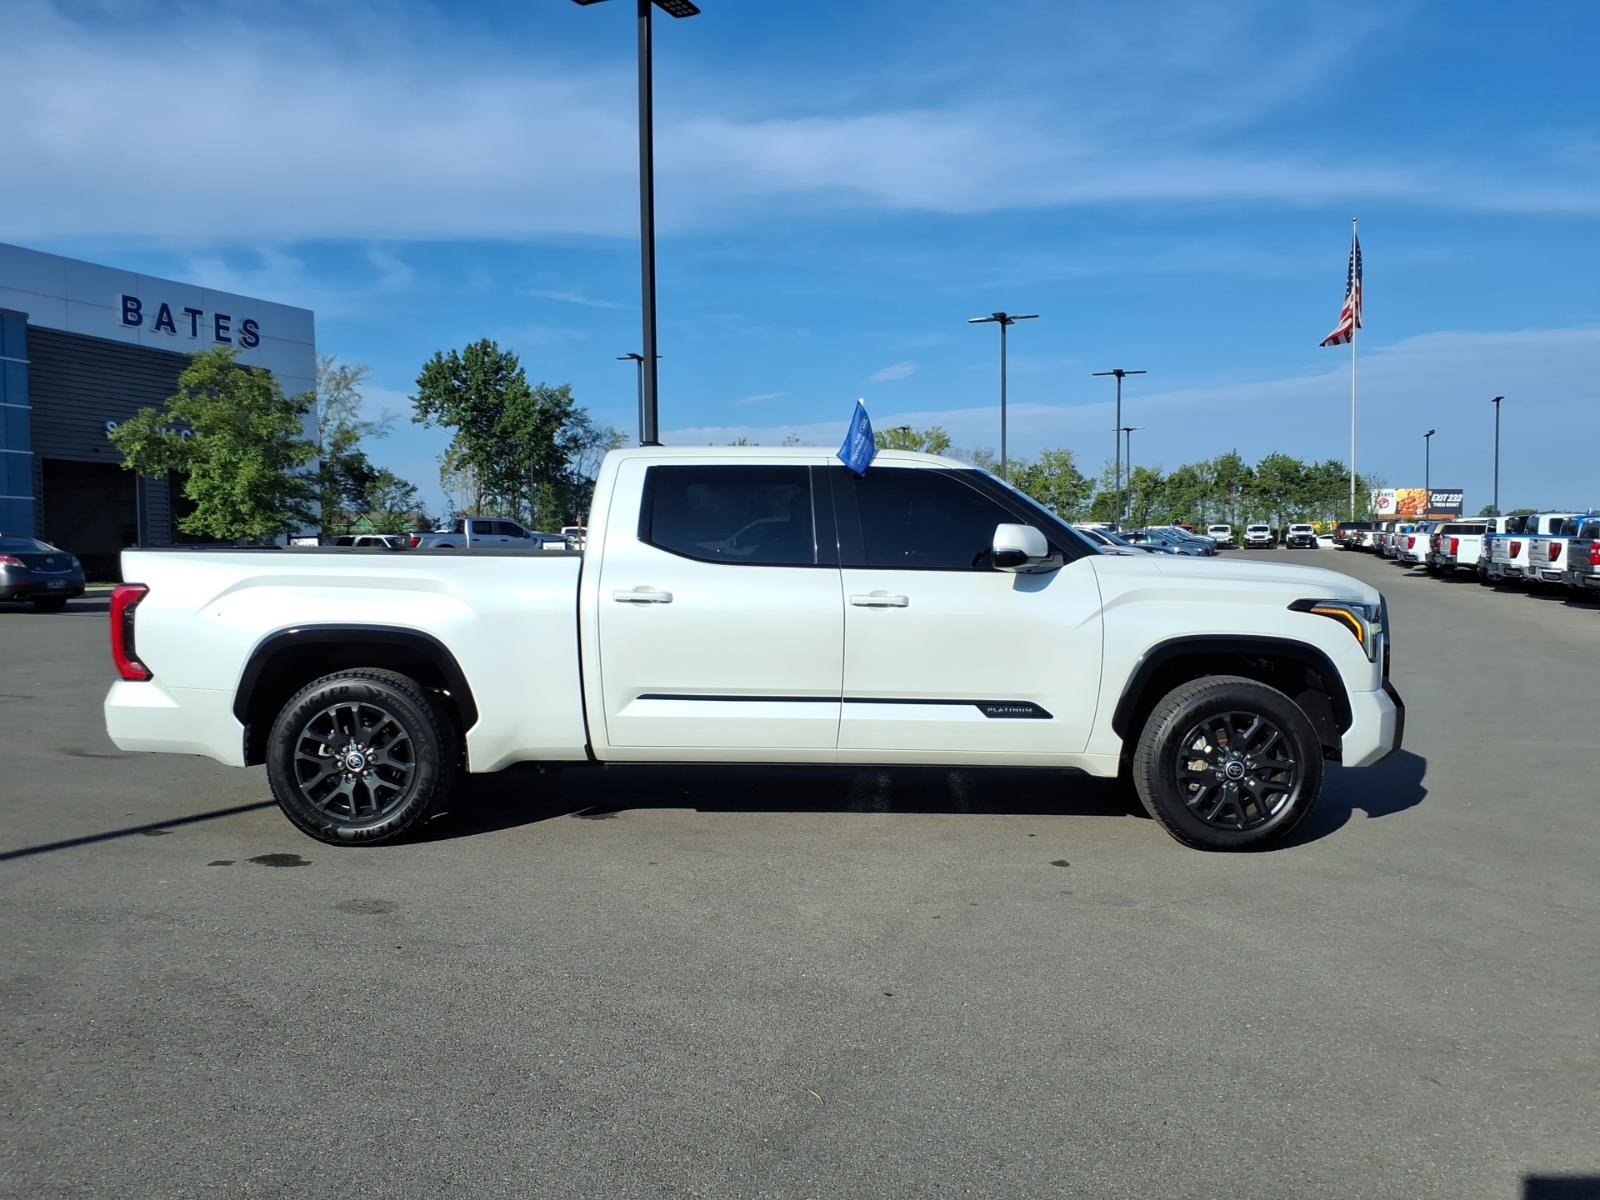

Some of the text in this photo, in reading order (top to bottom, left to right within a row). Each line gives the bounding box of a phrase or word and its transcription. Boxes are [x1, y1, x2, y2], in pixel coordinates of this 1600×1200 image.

[121, 294, 260, 348] BATES
[1431, 493, 1462, 502] EXIT 232
